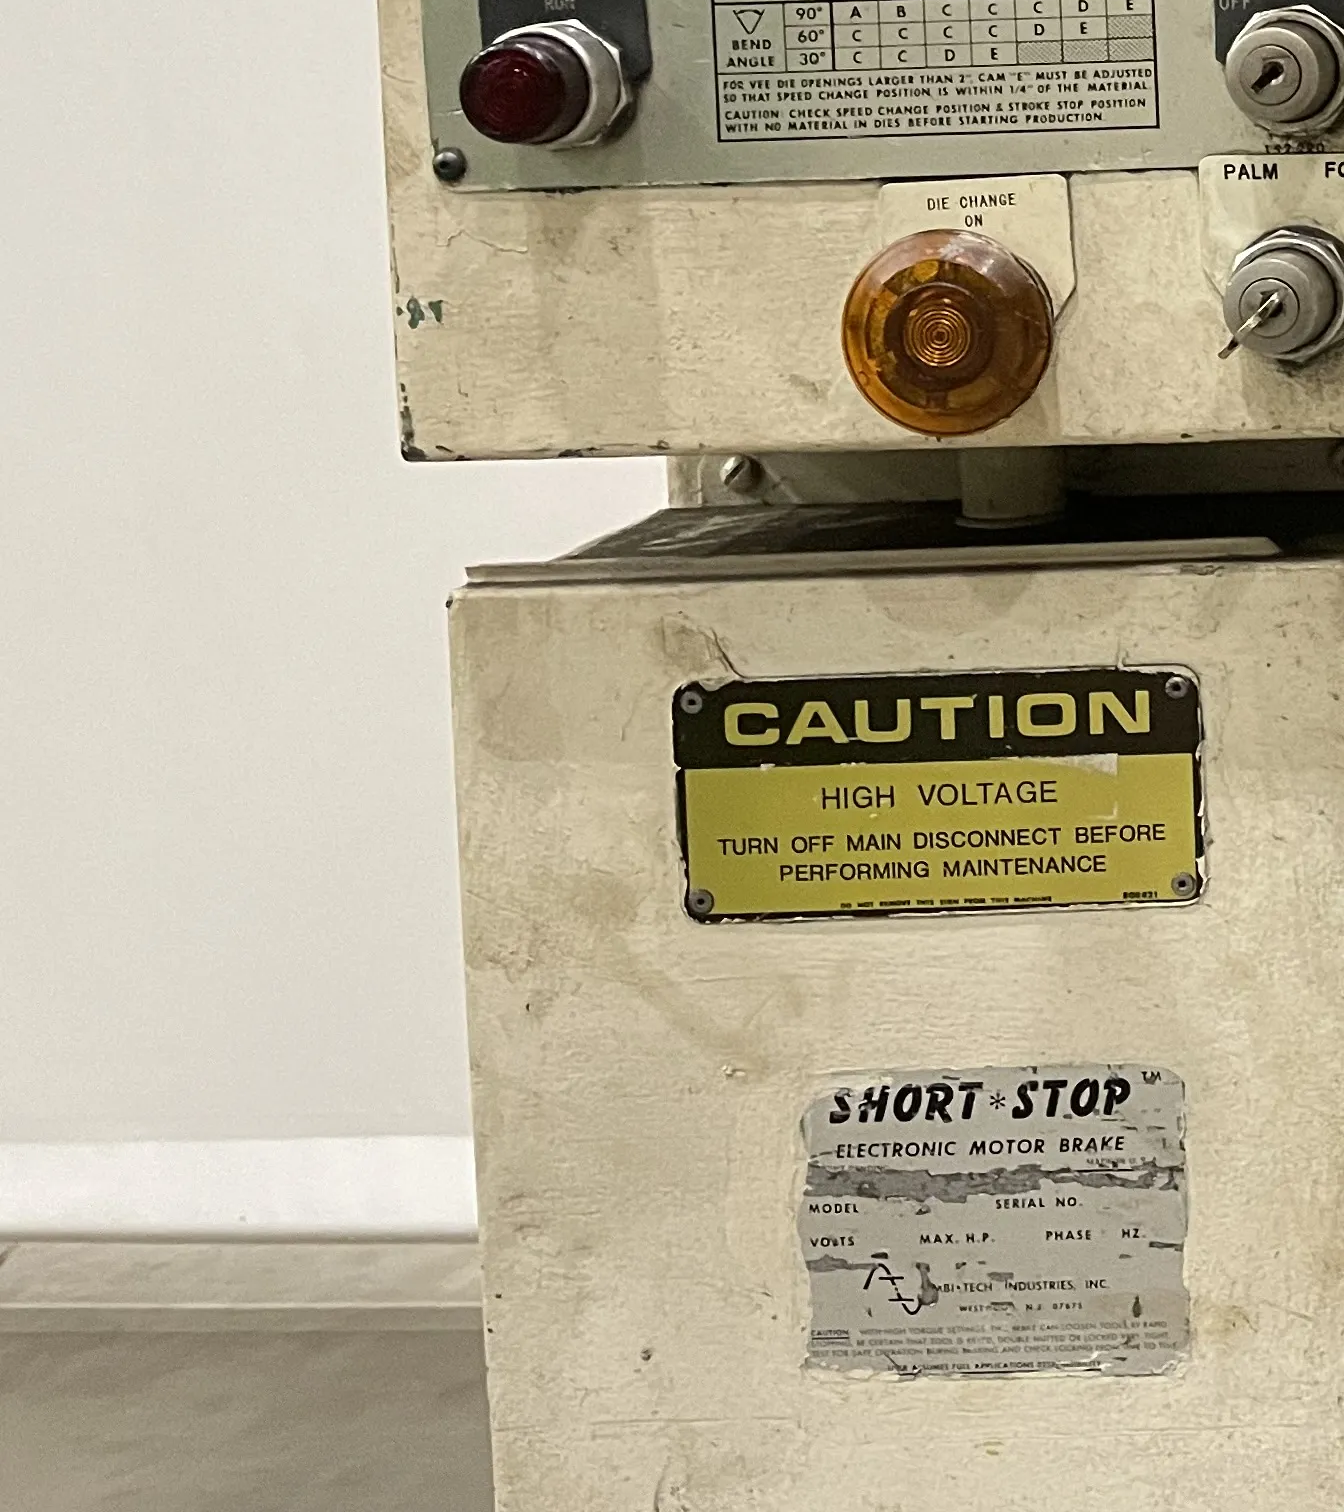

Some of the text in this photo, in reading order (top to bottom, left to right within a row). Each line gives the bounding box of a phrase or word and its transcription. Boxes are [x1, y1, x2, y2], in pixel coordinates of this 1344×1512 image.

[1223, 163, 1279, 180] PALM
[927, 193, 1017, 211] DIE CHANGE
[964, 214, 983, 227] ON
[724, 690, 1151, 747] CAUTION
[820, 780, 1058, 810] HIGH VOLTAGE
[717, 824, 1166, 857] TURN OFF MAIN DISCONNECT BEFORE
[780, 855, 1107, 882] PERFORMING MAINTENANCE
[836, 1136, 1125, 1159] ELECTRONIC MOTOR BRAKE
[808, 1203, 860, 1215] MODEL
[995, 1196, 1084, 1210] SERIAL NO.
